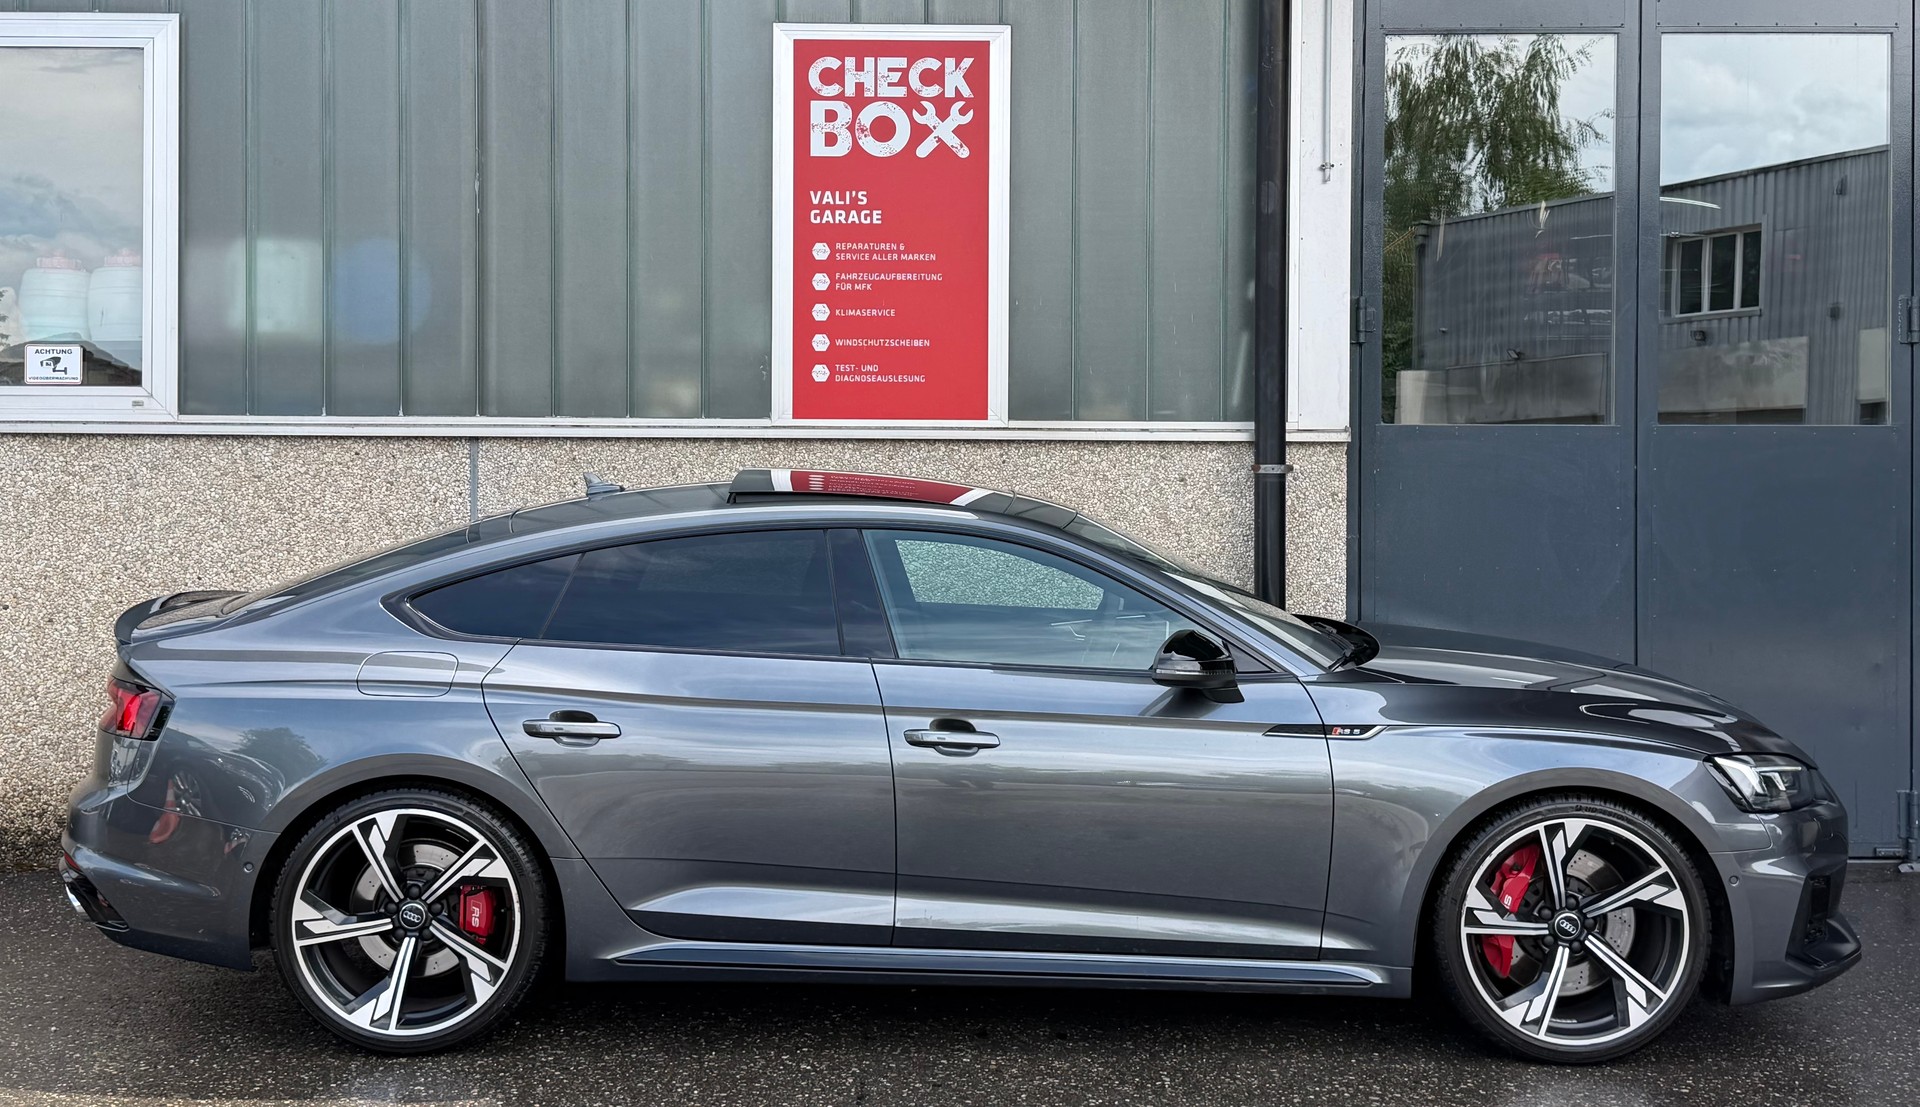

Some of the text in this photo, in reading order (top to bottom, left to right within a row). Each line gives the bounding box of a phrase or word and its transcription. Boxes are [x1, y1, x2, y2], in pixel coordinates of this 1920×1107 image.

[807, 56, 975, 99] CHECK
[809, 190, 868, 206] VALI'S
[810, 209, 882, 225] GARAGE
[835, 242, 905, 251] REPARATUREN &
[835, 253, 936, 261] SERVICE ALLER MARKEN
[835, 272, 943, 281] FAHRZEUGAUFBEREITUNG
[835, 282, 872, 291] FÜR MFK
[835, 308, 896, 317] KLIMASERVICE
[835, 338, 930, 347] WINDSCHUTZSCHEIBEN
[835, 364, 879, 372] TEST- UND
[835, 374, 926, 383] DIAGNOSEAUSLESUNG
[471, 906, 480, 928] RS
